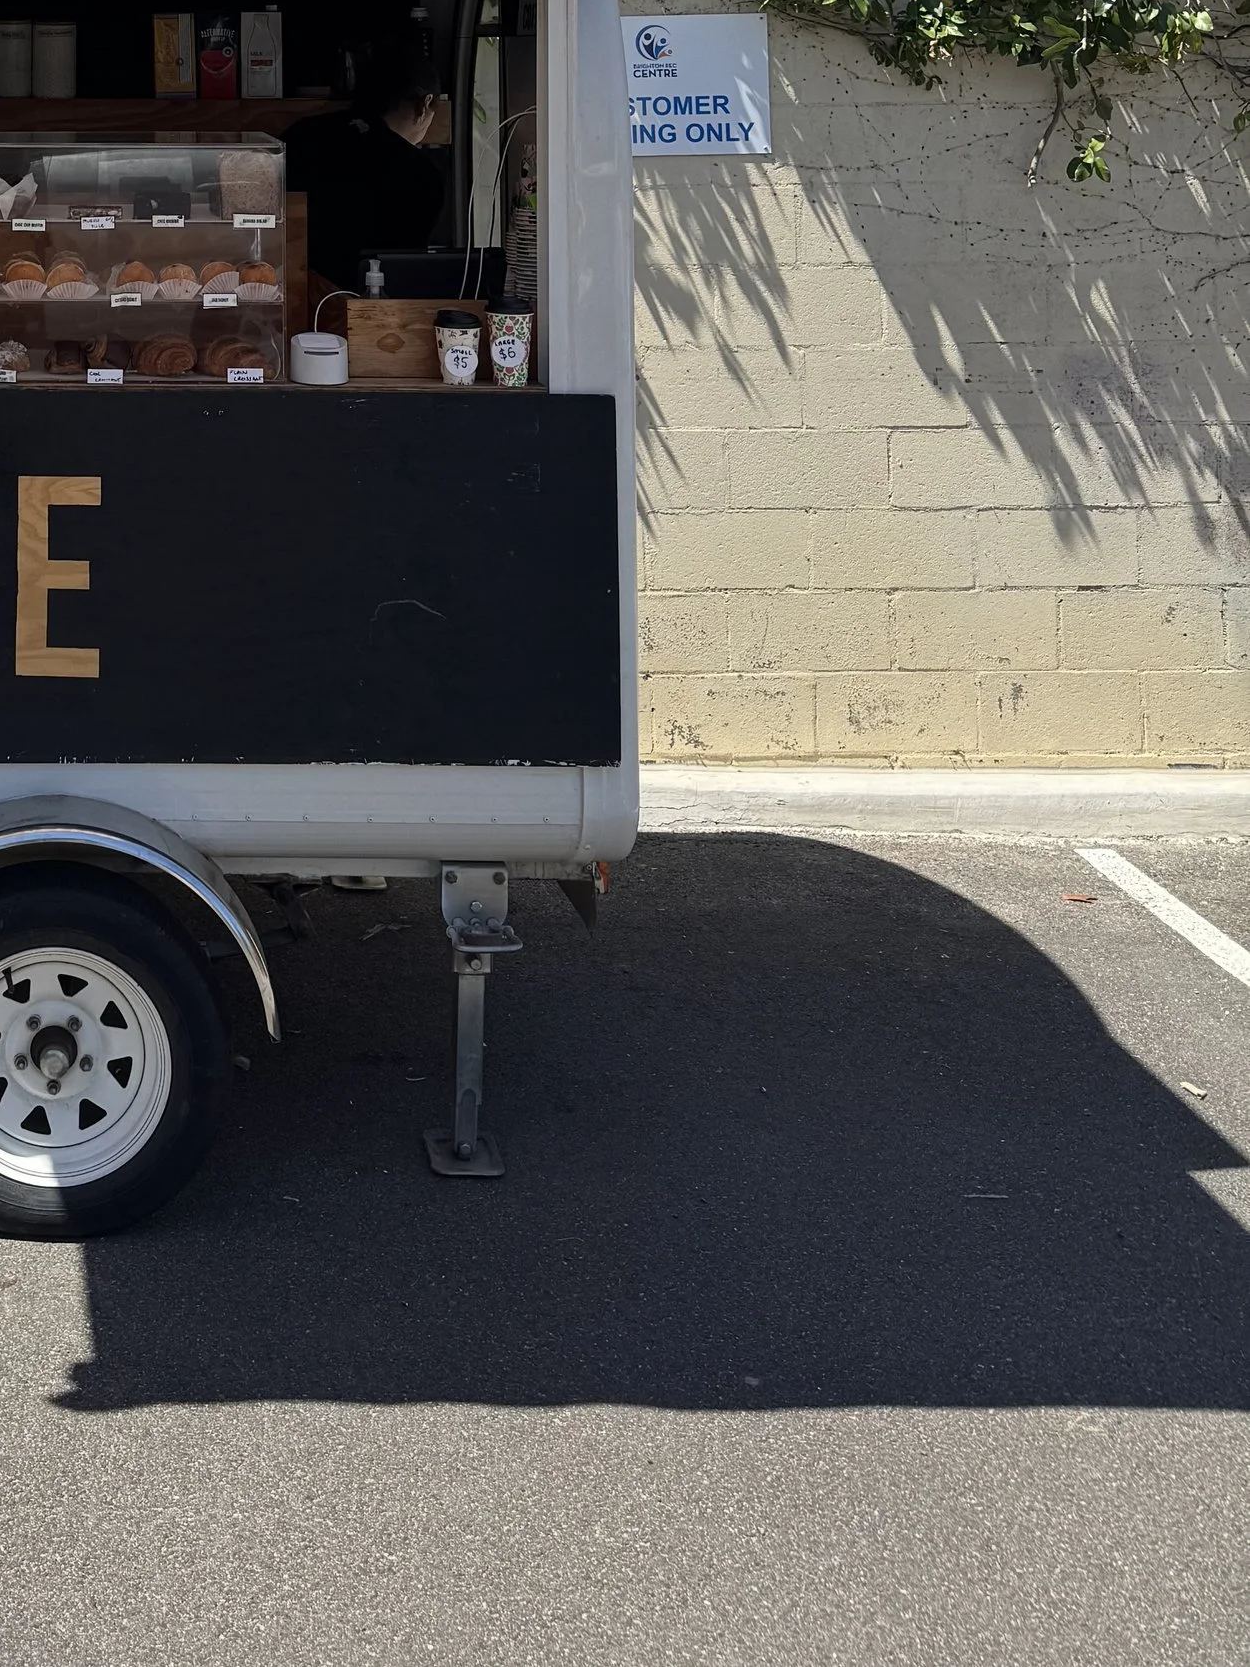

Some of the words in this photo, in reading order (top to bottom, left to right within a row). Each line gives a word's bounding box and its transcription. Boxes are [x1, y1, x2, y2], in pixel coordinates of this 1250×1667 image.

[633, 69, 678, 78] CENTRE
[632, 123, 677, 144] ING
[685, 122, 755, 143] ONLY
[494, 339, 516, 347] LARGE
[450, 348, 473, 356] SMALL
[498, 347, 516, 361] $6
[453, 354, 468, 369] $5
